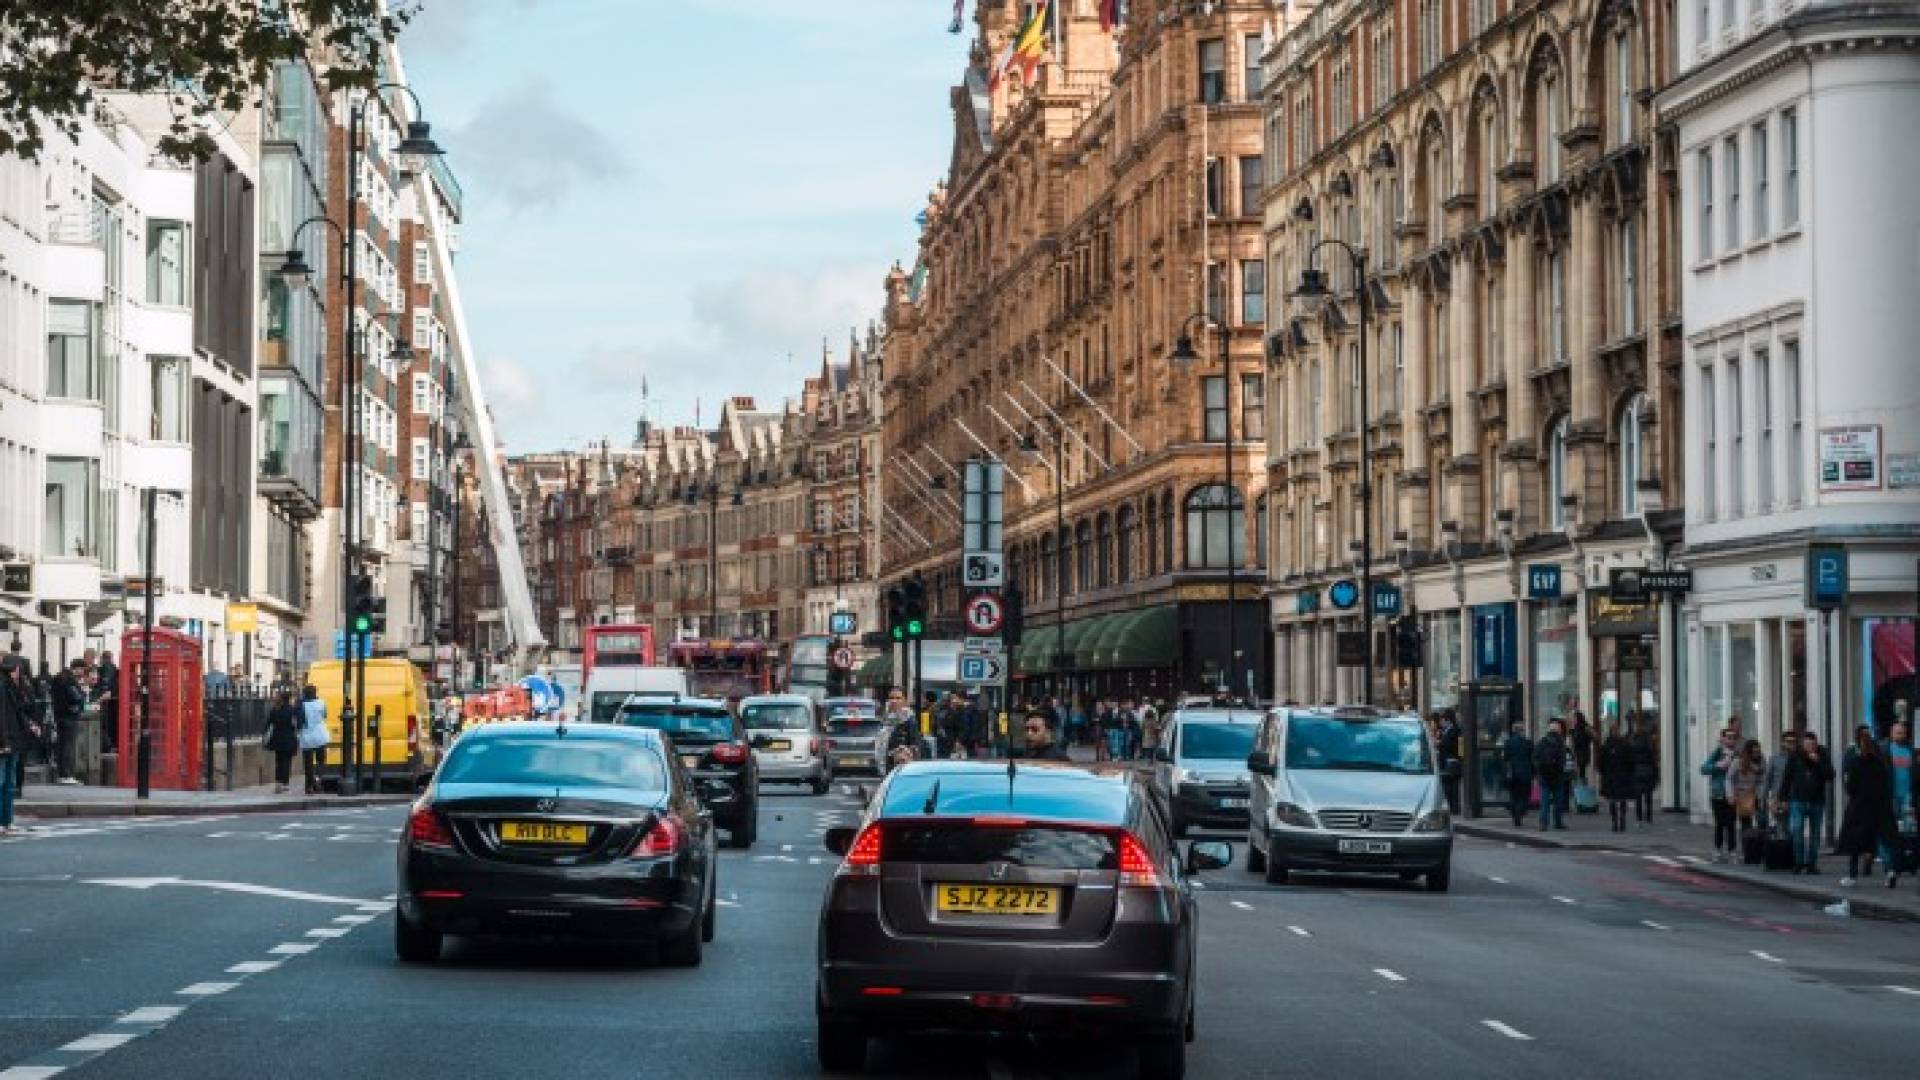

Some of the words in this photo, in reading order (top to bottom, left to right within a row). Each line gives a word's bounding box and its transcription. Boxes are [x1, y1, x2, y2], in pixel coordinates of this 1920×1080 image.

[1641, 576, 1690, 588] PINKO
[968, 660, 981, 676] P
[947, 887, 988, 907] SJZ
[993, 887, 1049, 908] 2272
